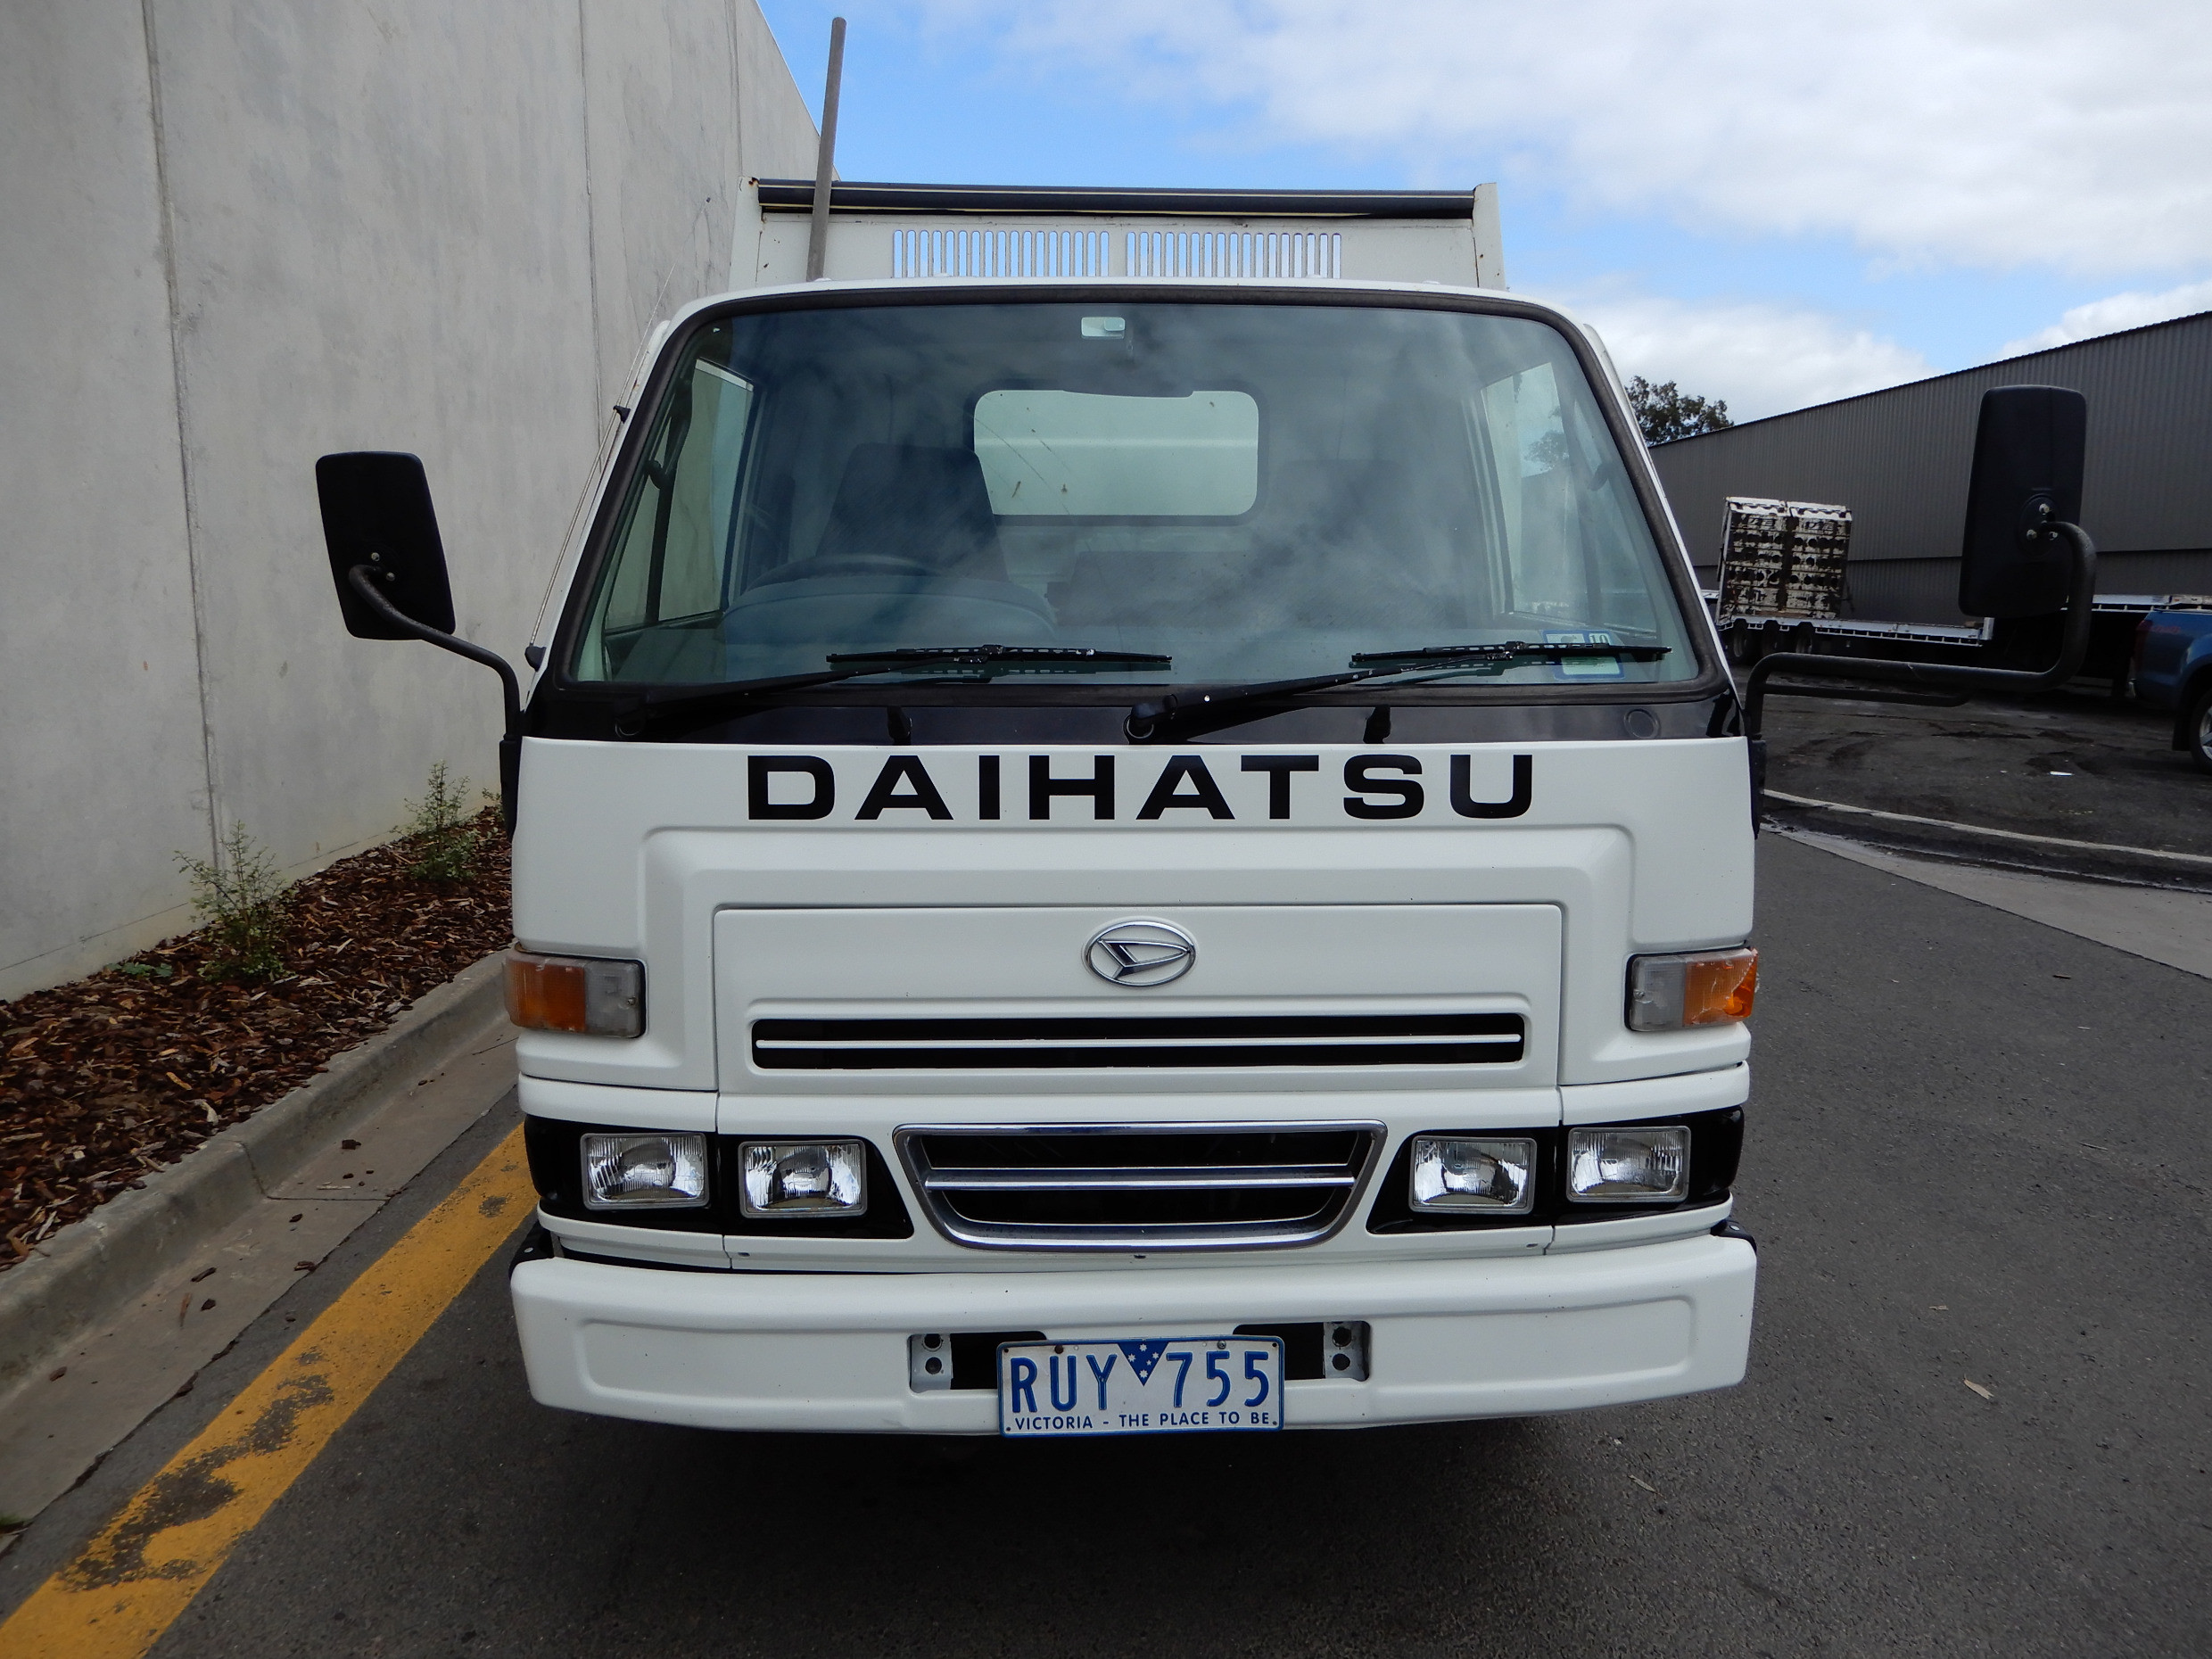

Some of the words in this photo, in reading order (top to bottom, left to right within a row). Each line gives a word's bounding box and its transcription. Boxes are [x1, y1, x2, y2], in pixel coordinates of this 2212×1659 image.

[747, 754, 1533, 820] DAIHATSU
[1010, 1353, 1118, 1414] RUY
[1166, 1350, 1270, 1408] 755
[1014, 1415, 1094, 1431] VICTORIA
[1118, 1413, 1150, 1427] THE
[1160, 1411, 1209, 1426] PLACE
[1218, 1411, 1241, 1424] TO
[1250, 1411, 1269, 1424] BE
